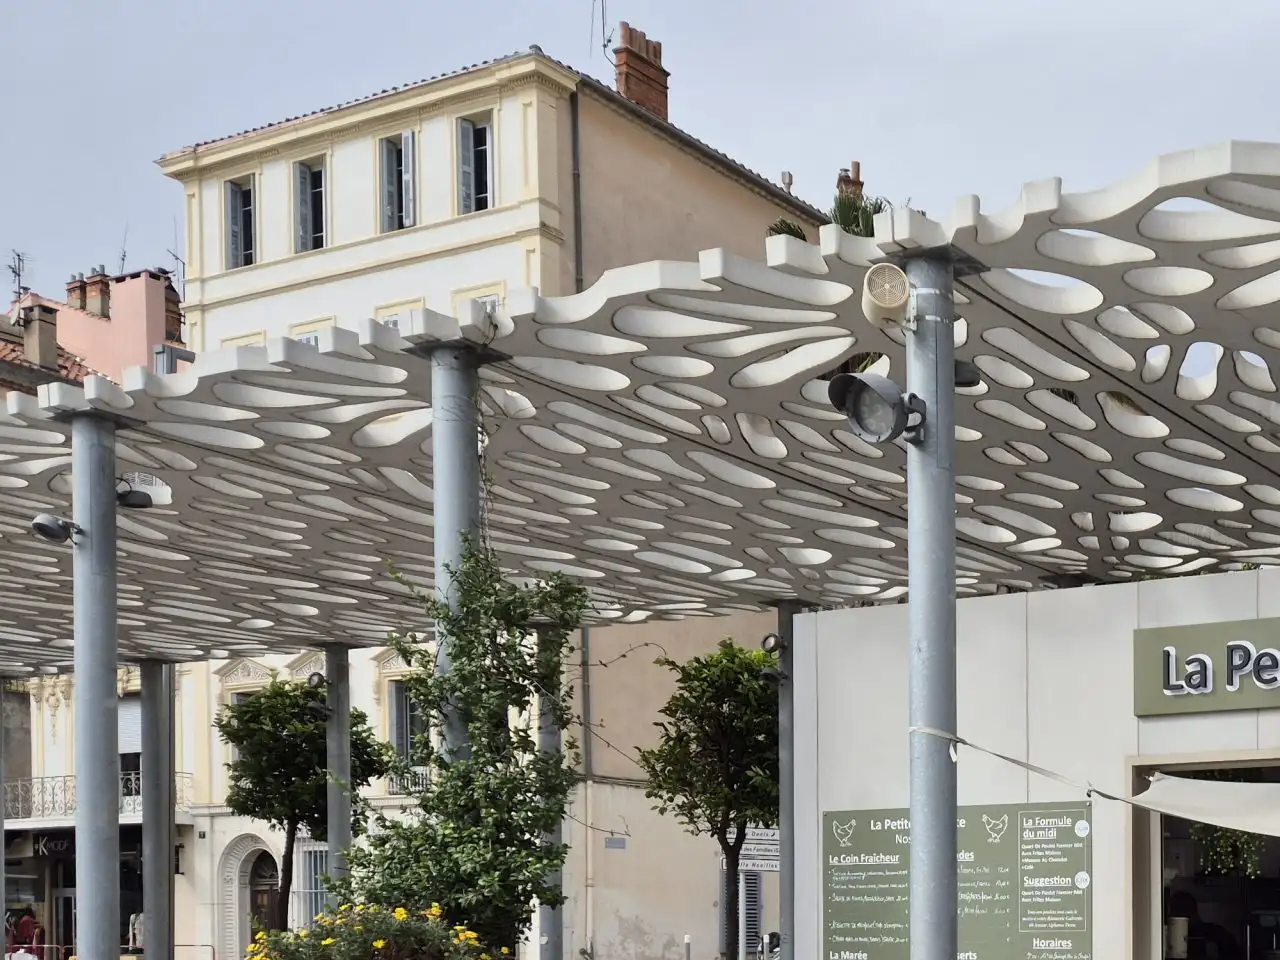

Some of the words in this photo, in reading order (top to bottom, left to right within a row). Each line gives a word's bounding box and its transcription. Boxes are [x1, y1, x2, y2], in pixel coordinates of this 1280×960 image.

[1162, 646, 1212, 695] La
[871, 820, 881, 830] La
[1036, 816, 1071, 825] Formule
[1024, 829, 1034, 838] du
[1037, 828, 1056, 837] midi
[829, 855, 839, 864] Le
[841, 854, 858, 863] Coin
[1024, 875, 1072, 887] Suggestion
[1033, 938, 1072, 947] Horaires
[830, 951, 838, 959] La
[841, 950, 867, 960] Marée
